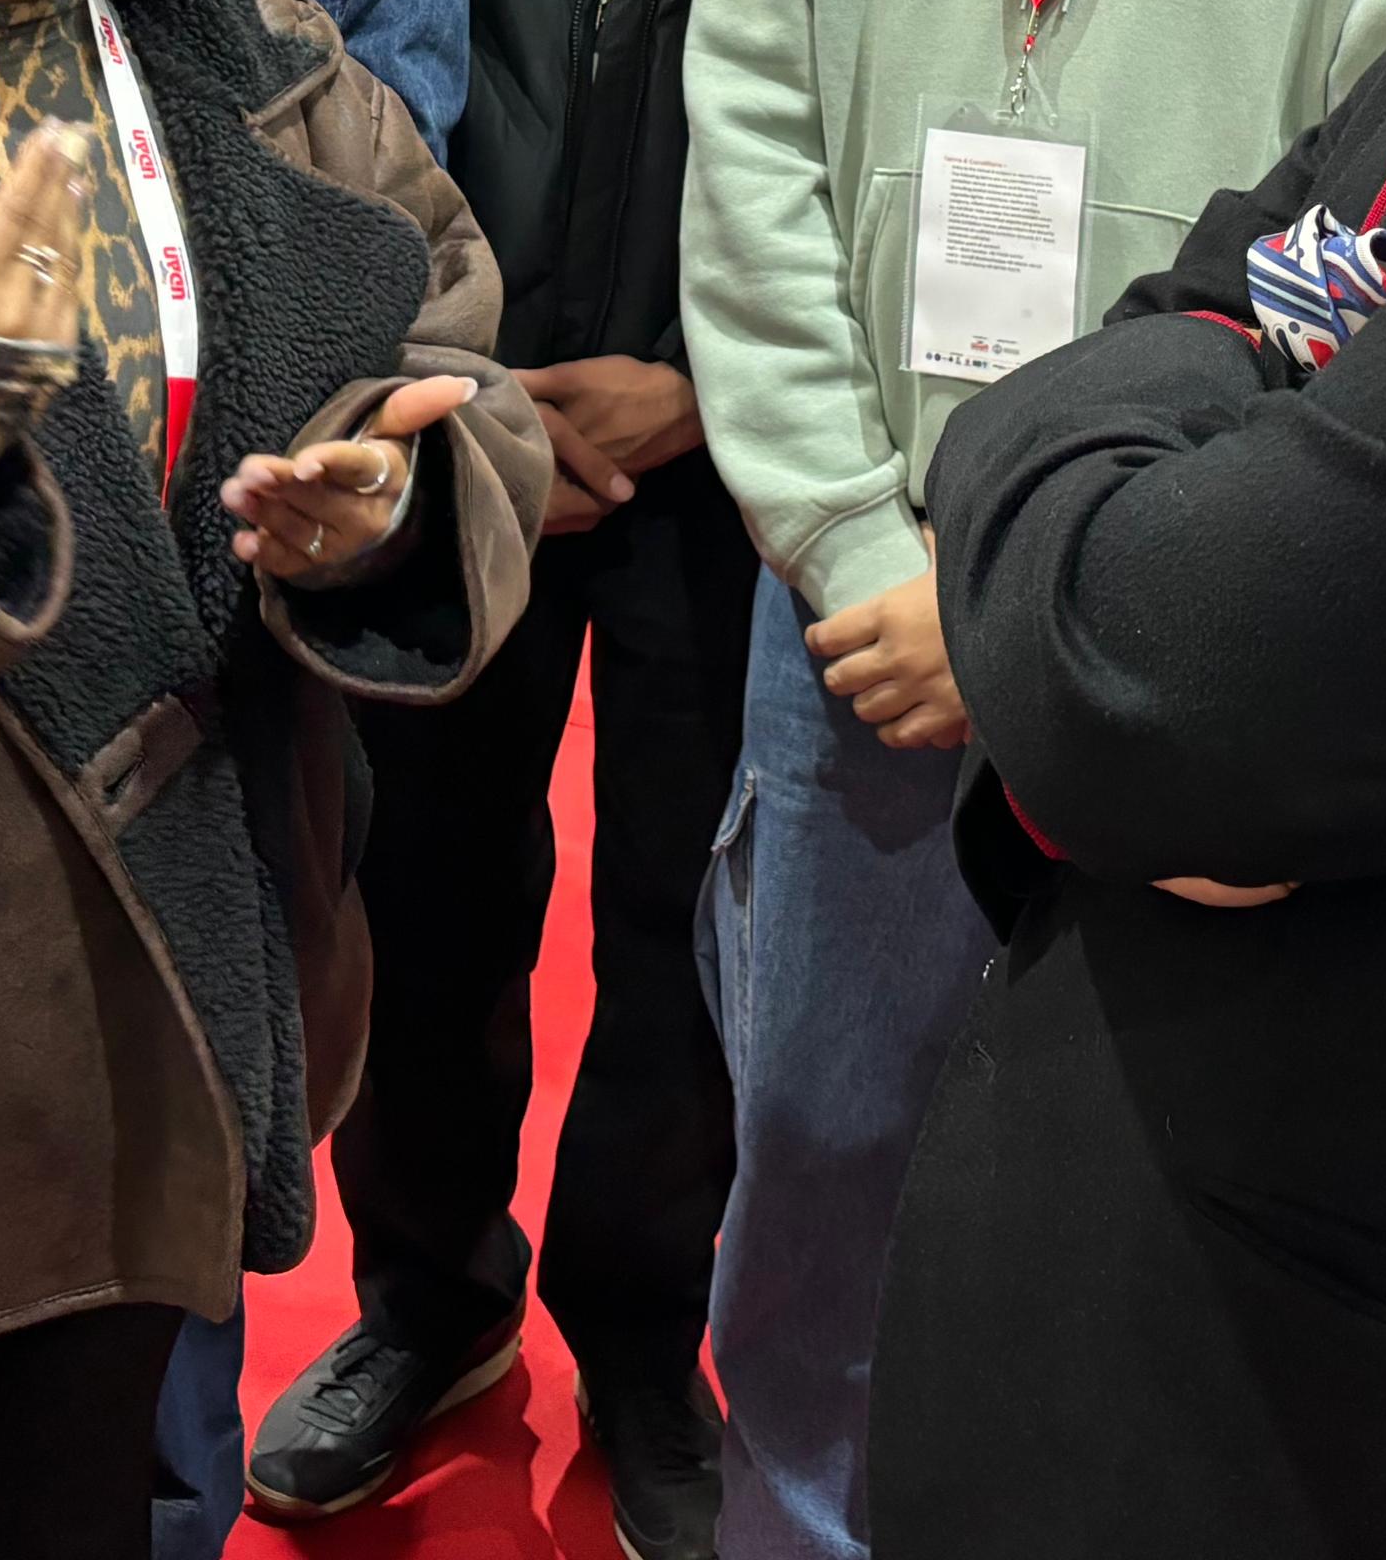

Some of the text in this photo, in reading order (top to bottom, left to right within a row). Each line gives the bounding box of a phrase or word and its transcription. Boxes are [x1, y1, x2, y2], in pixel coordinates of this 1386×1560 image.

[99, 16, 124, 65] UDAN
[132, 129, 157, 180] UDAN
[163, 246, 185, 300] UDAN
